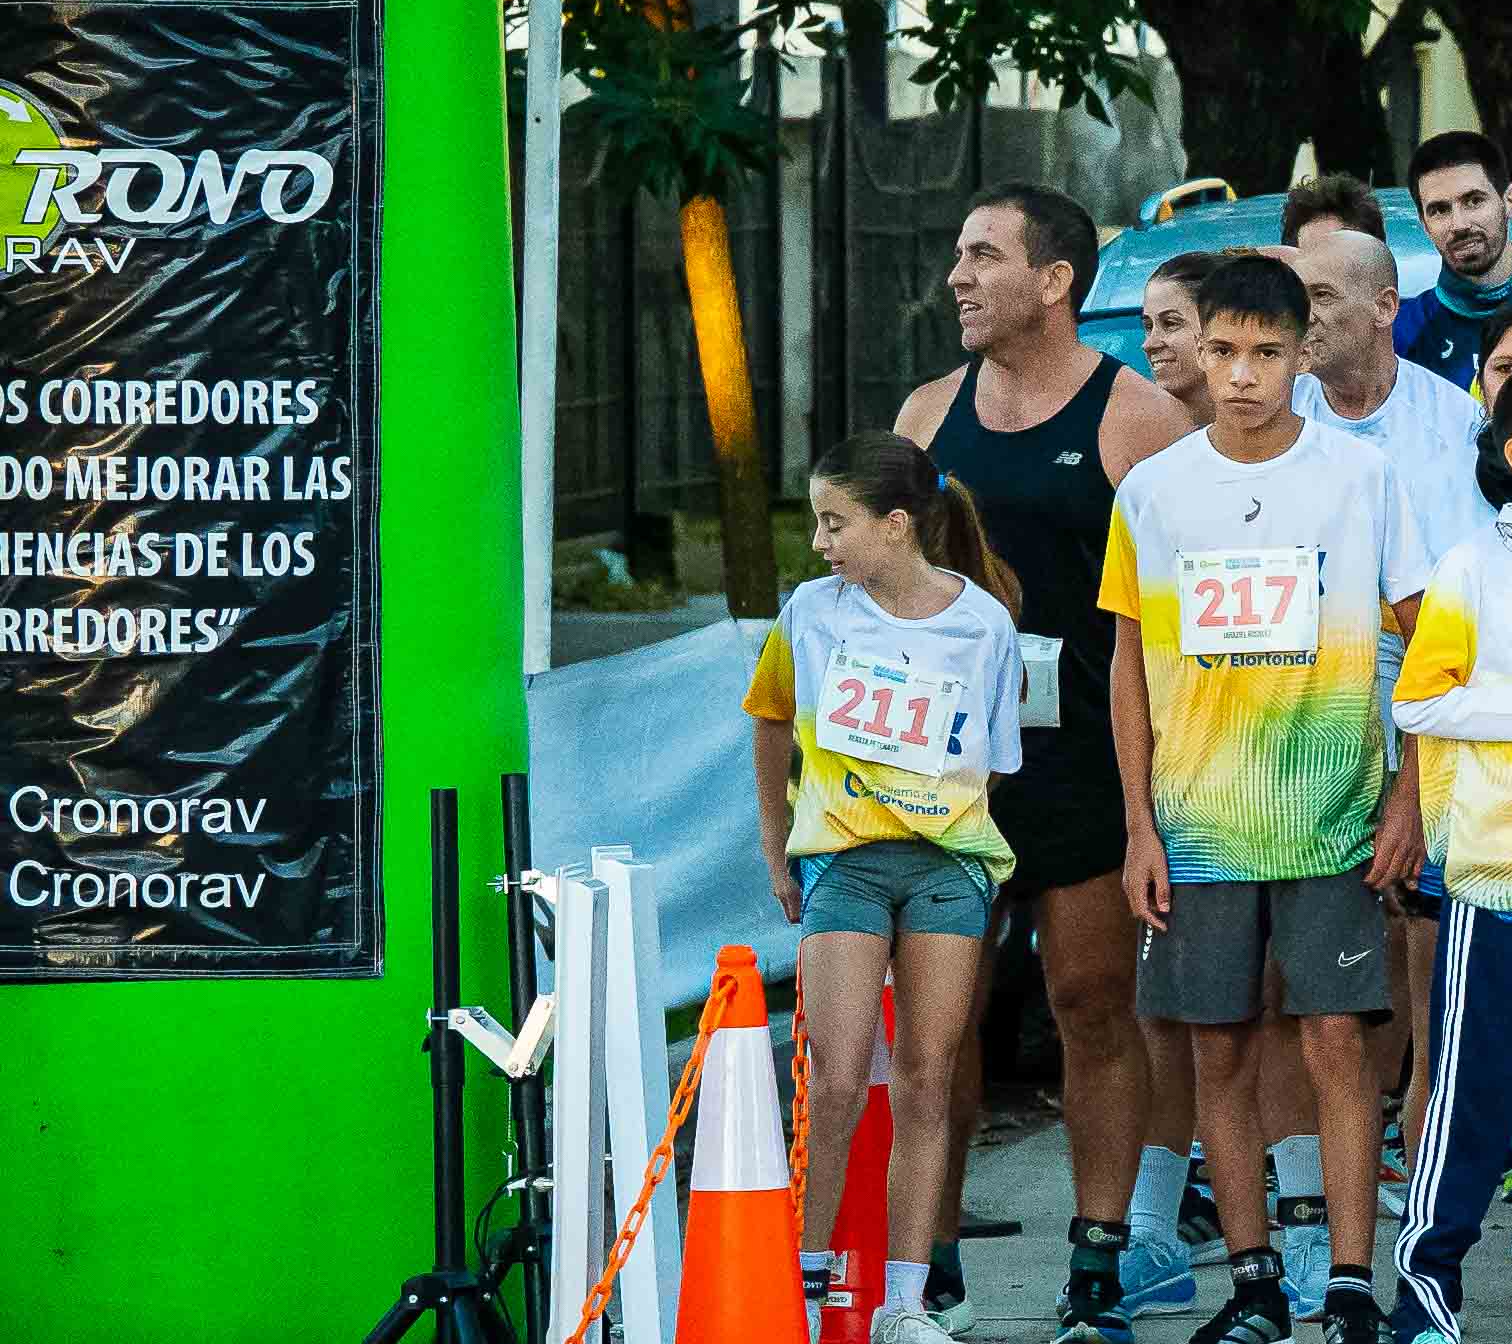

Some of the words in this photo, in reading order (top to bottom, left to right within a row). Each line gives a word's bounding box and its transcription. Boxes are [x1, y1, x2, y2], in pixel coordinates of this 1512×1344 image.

[5, 237, 137, 275] RAV
[39, 379, 320, 425] CORREDORES
[64, 456, 271, 501] MEJORAR
[283, 456, 352, 501] LAS
[175, 532, 230, 577] DE
[242, 532, 316, 577] LOS
[1194, 576, 1298, 627] 217
[828, 678, 930, 747] 211
[9, 786, 267, 834] Cronorav
[8, 861, 266, 909] Cronorav
